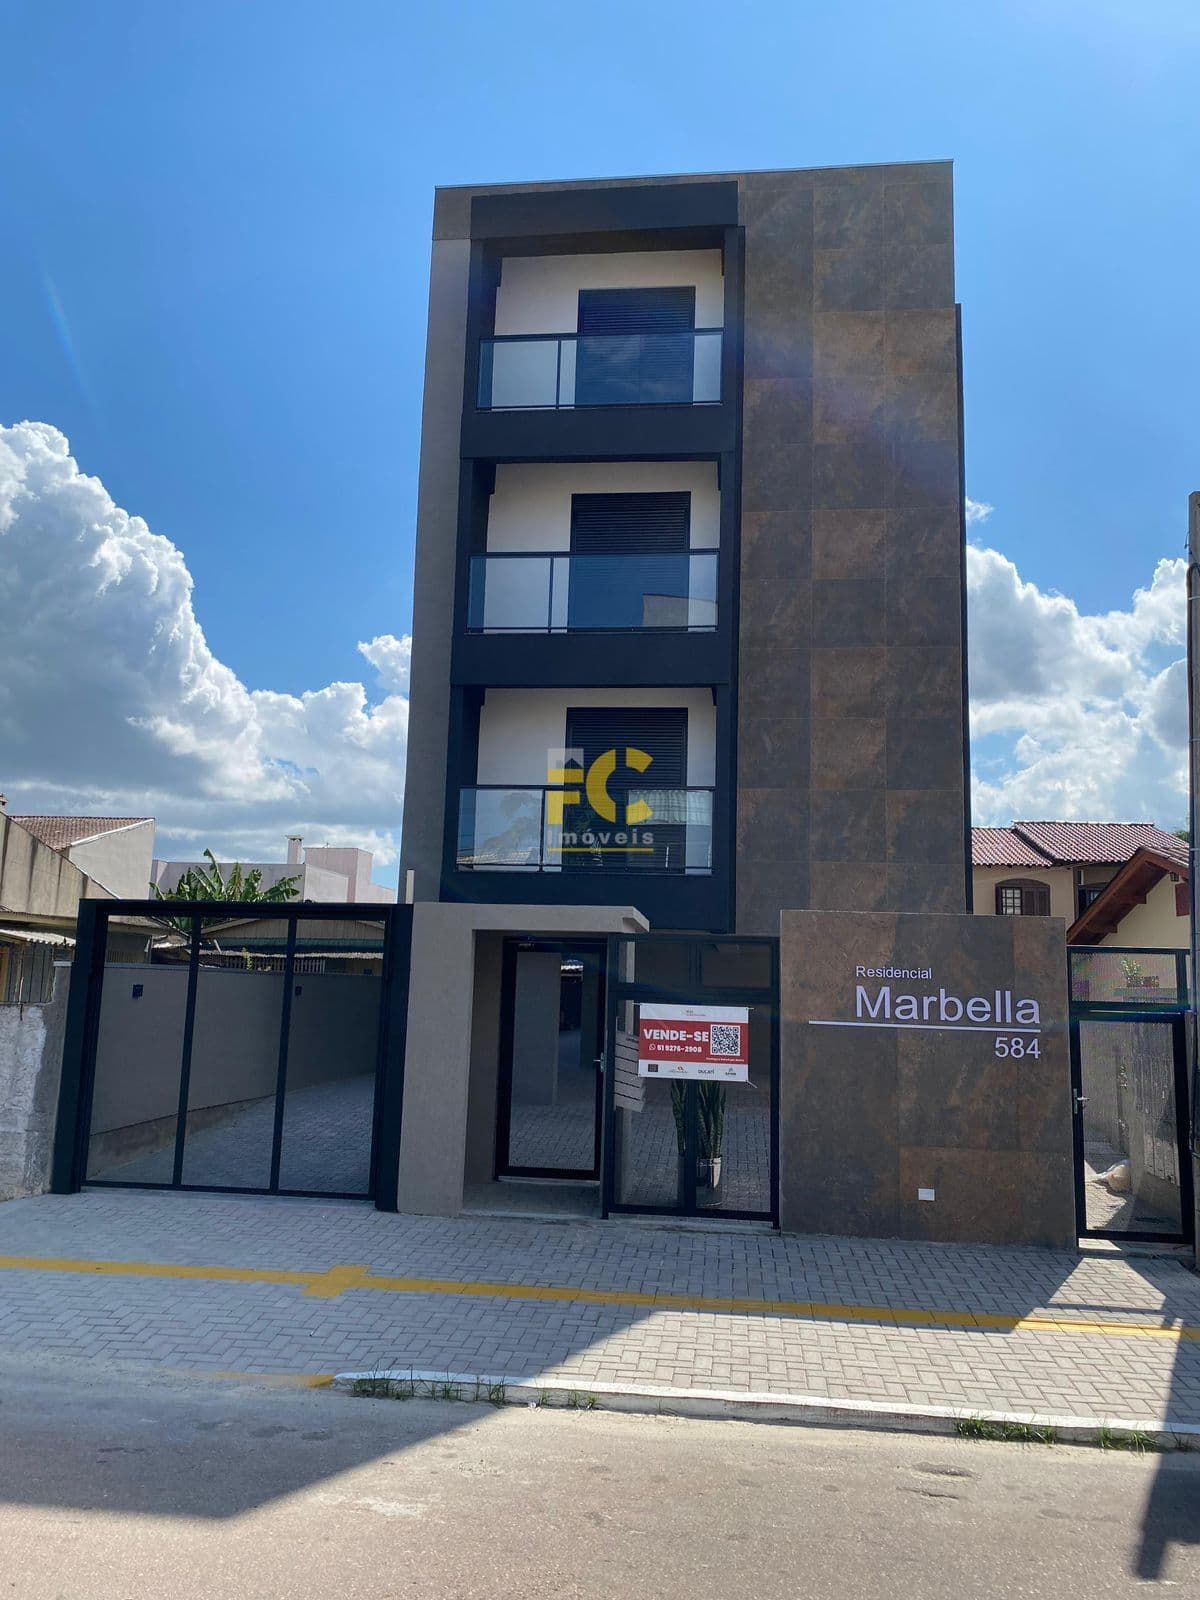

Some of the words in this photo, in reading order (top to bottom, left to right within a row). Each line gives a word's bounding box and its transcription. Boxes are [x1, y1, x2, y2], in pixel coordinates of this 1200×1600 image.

[856, 966, 932, 979] Residencial
[856, 985, 1041, 1024] Marbella
[643, 1028, 709, 1042] VENDE-SE
[995, 1037, 1041, 1059] 584
